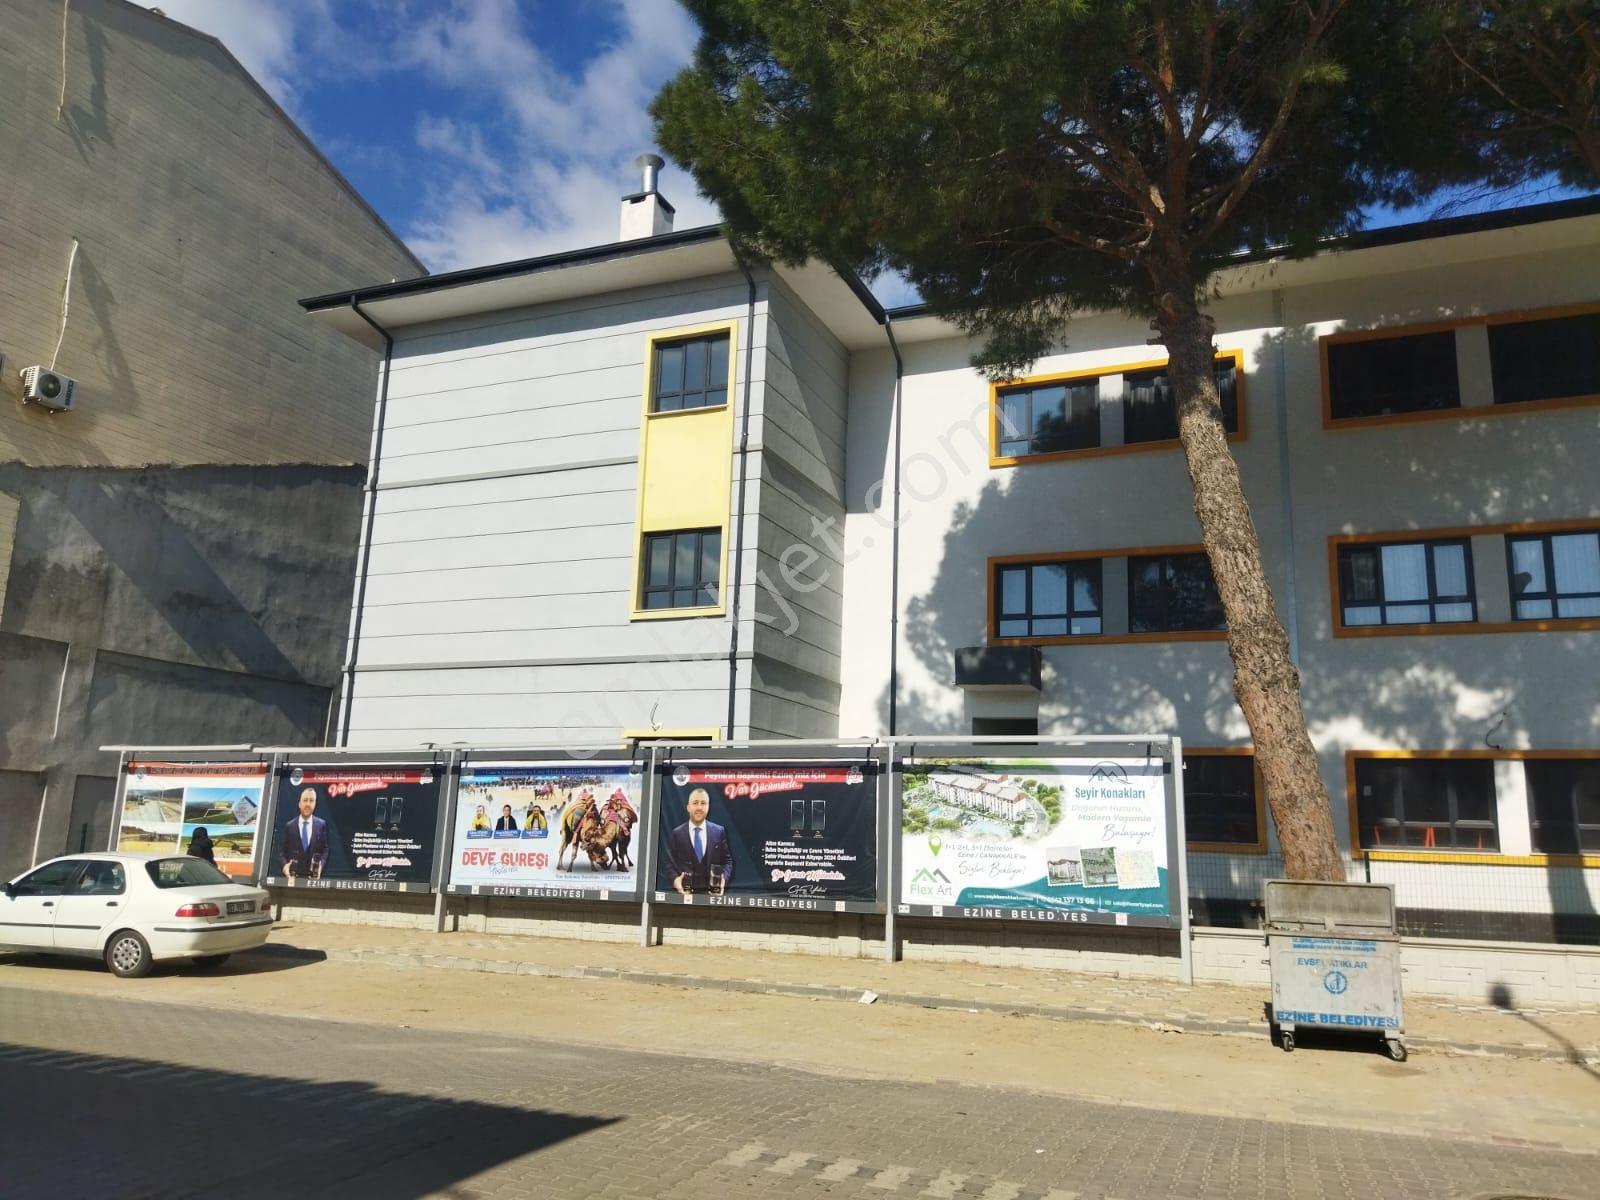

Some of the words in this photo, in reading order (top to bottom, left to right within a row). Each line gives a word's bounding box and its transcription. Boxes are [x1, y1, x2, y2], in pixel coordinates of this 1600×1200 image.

[1075, 787, 1099, 800] Seyir
[1101, 787, 1146, 799] Konakları
[462, 851, 497, 866] DEVE
[493, 886, 521, 896] EZİNE
[527, 888, 585, 899] BELEDİYESİ
[910, 884, 933, 895] Flex
[937, 885, 952, 896] Art
[710, 895, 742, 906] EZİNE
[963, 907, 1002, 918] EZİNE
[1276, 1010, 1316, 1024] EZİNE
[1319, 1013, 1399, 1028] BELEDİYESİ
